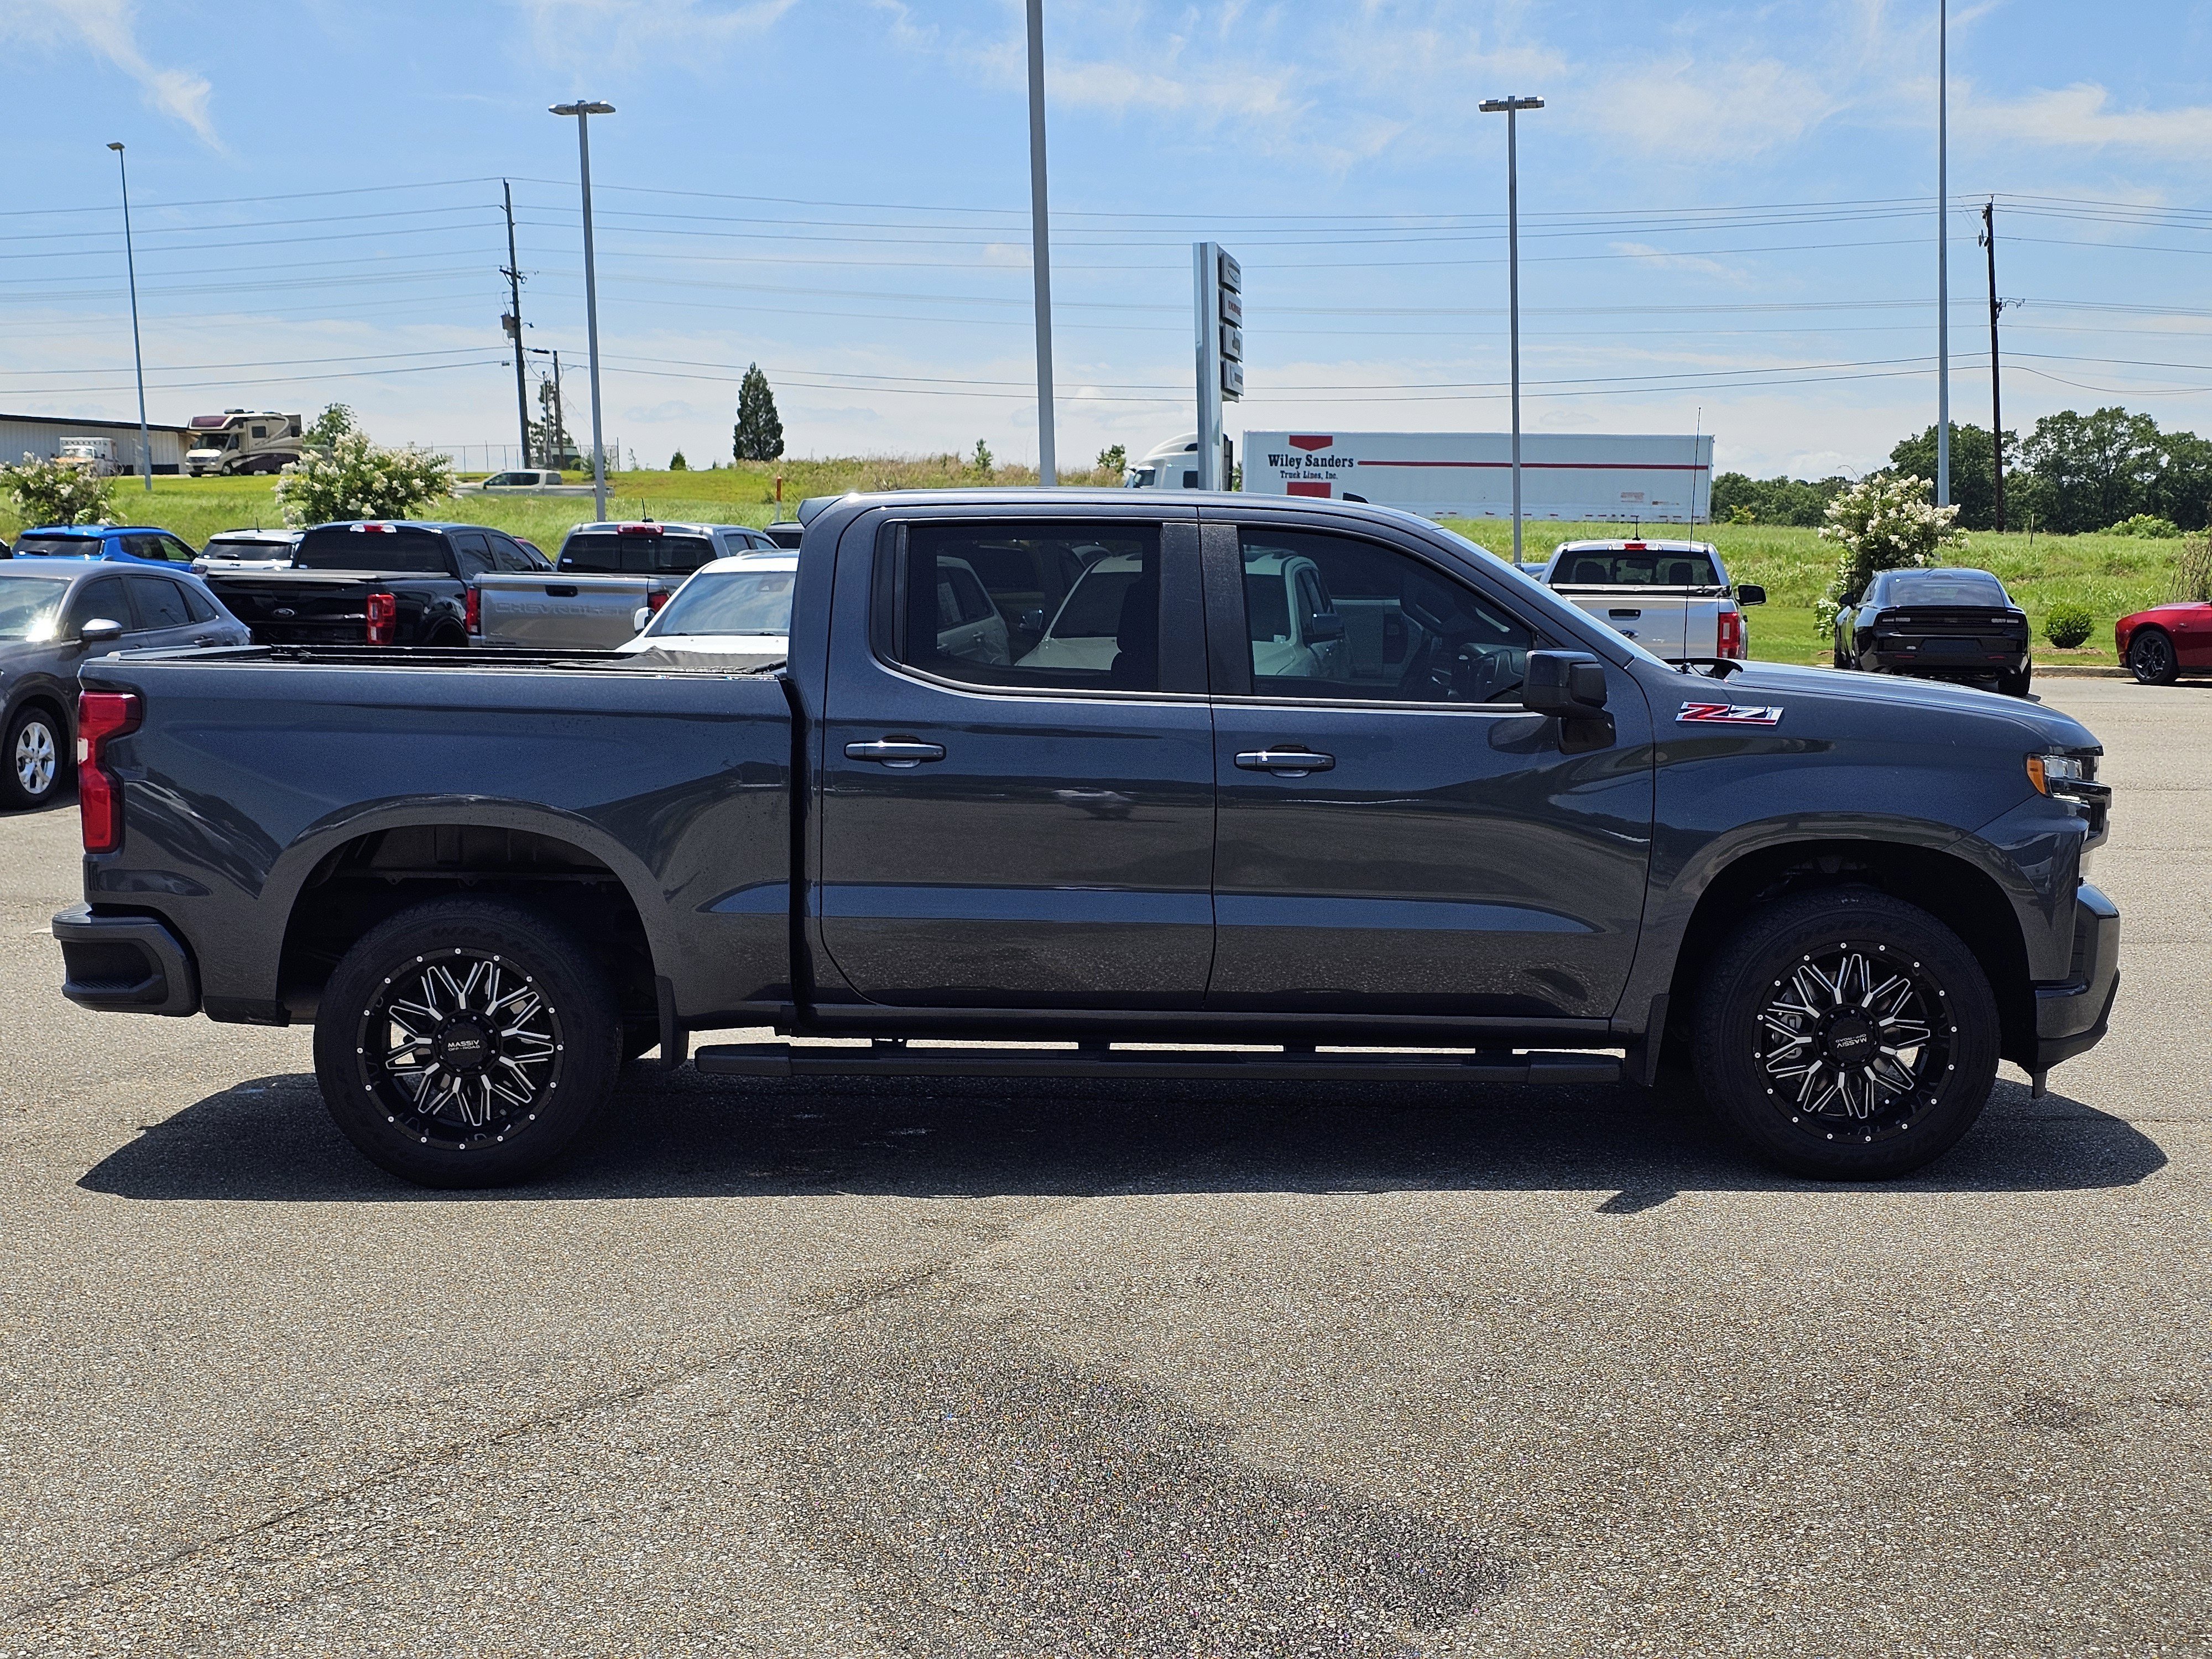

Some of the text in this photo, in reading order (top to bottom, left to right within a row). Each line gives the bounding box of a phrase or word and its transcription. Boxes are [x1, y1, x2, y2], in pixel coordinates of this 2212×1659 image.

[1268, 454, 1354, 469] Wiley Sanders
[1280, 470, 1338, 479] Truck Lines, Inc.
[1676, 701, 1784, 725] Z71
[1837, 1037, 1866, 1048] MASSIV
